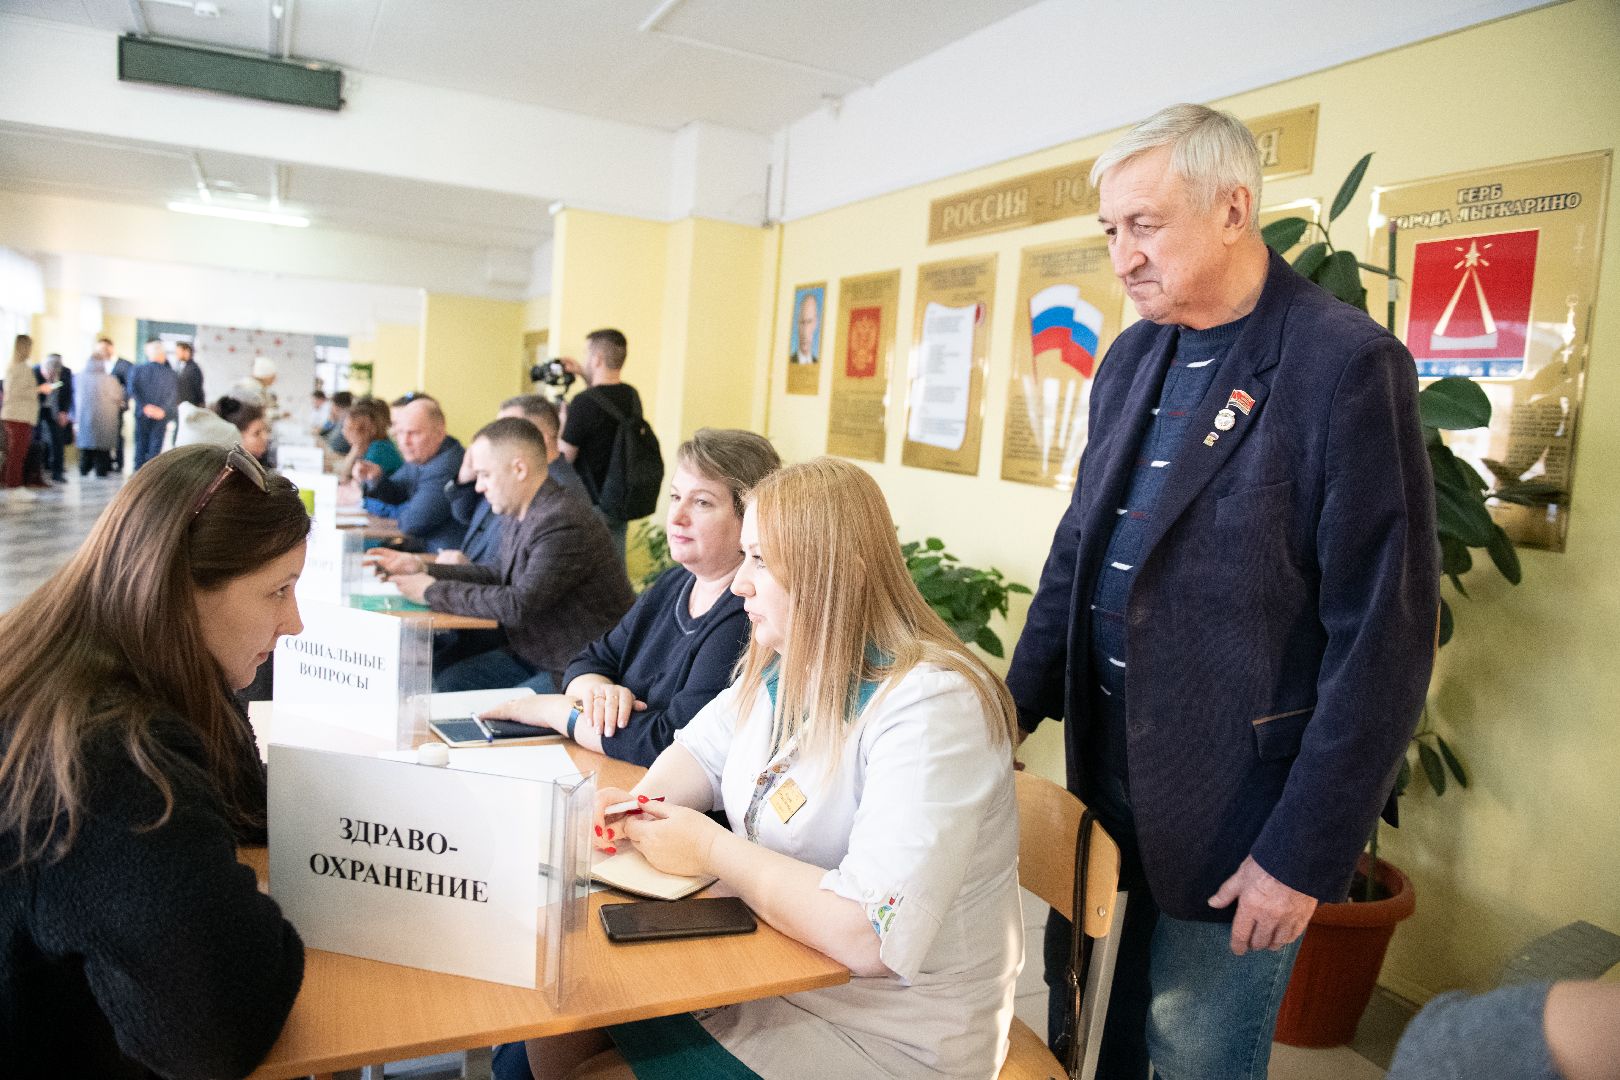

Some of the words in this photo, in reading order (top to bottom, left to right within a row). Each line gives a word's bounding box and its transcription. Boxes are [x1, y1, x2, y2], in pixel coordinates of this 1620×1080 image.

[942, 186, 1030, 232] РОССИЯ
[1256, 127, 1283, 167] Я
[1457, 183, 1503, 204] ГЕРБ
[1456, 192, 1582, 223] ЛЫТКАРИНО
[285, 637, 386, 671] СОЦИАЛЬНЫЕ
[299, 662, 369, 690] ВОПРОСЫ
[339, 817, 458, 855] ЗДРАВО-
[309, 853, 489, 904] ОХРАНЕНИЕ
